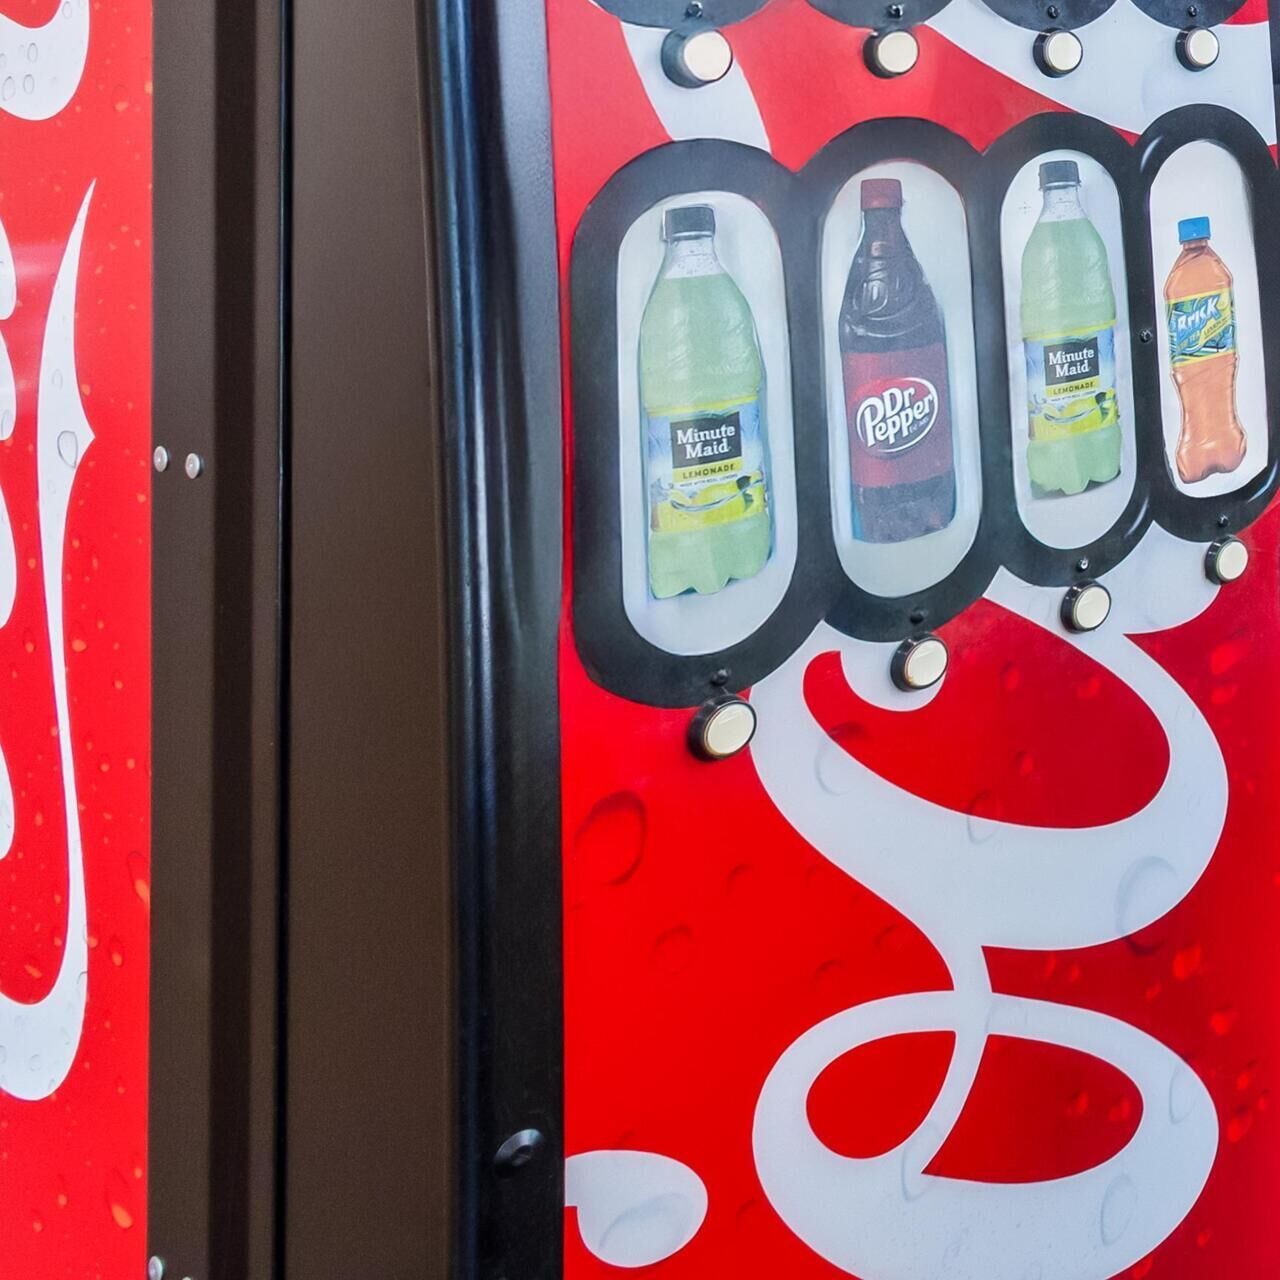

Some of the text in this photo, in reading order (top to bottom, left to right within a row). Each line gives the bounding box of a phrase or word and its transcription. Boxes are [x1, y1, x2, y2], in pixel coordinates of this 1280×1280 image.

[1048, 347, 1095, 366] Minute
[1055, 360, 1090, 378] Maid
[1053, 381, 1094, 396] LEMONADE
[882, 387, 916, 419] Dr
[856, 393, 933, 447] Pepper
[676, 424, 736, 445] Minute
[685, 438, 729, 459] Maid
[682, 463, 735, 480] LEMONADE
